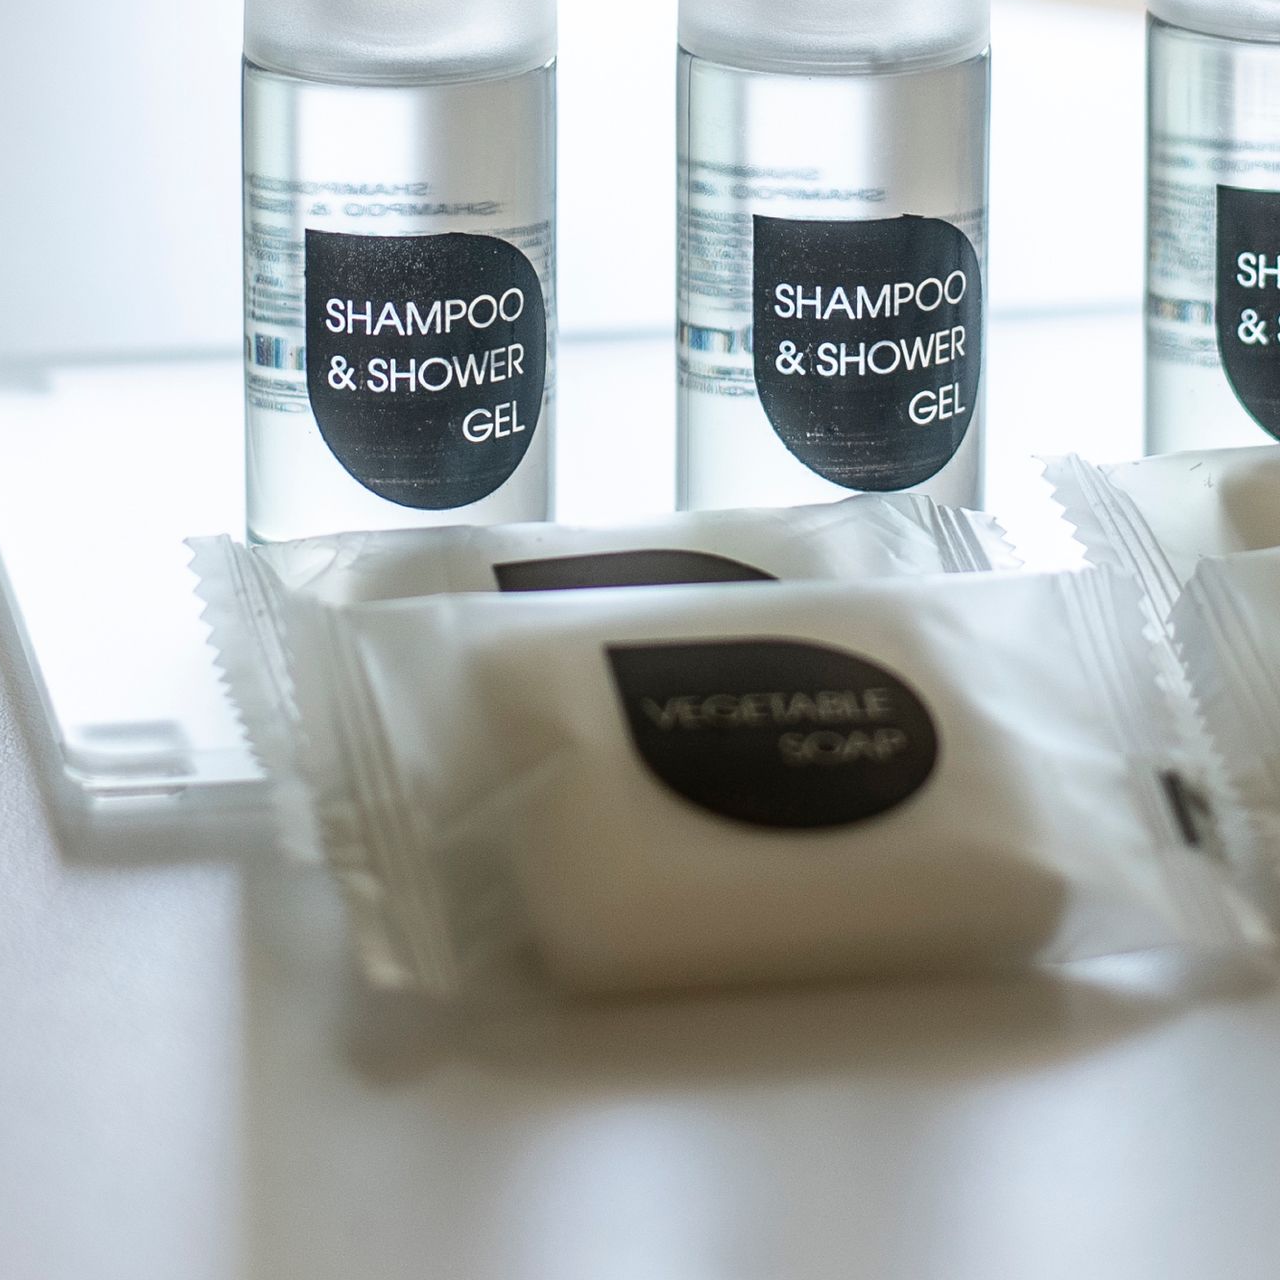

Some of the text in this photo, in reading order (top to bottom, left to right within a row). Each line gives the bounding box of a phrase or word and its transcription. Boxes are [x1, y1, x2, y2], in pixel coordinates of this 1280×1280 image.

[326, 287, 524, 336] SHAMPOO
[774, 270, 966, 320] SHAMPOO
[1237, 309, 1268, 344] &
[327, 343, 524, 393] & SHOWER
[775, 325, 966, 377] & SHOWER
[462, 400, 525, 442] GEL
[908, 383, 965, 425] GEL
[640, 686, 891, 730] VEGETABLE
[777, 726, 908, 768] SOAP
